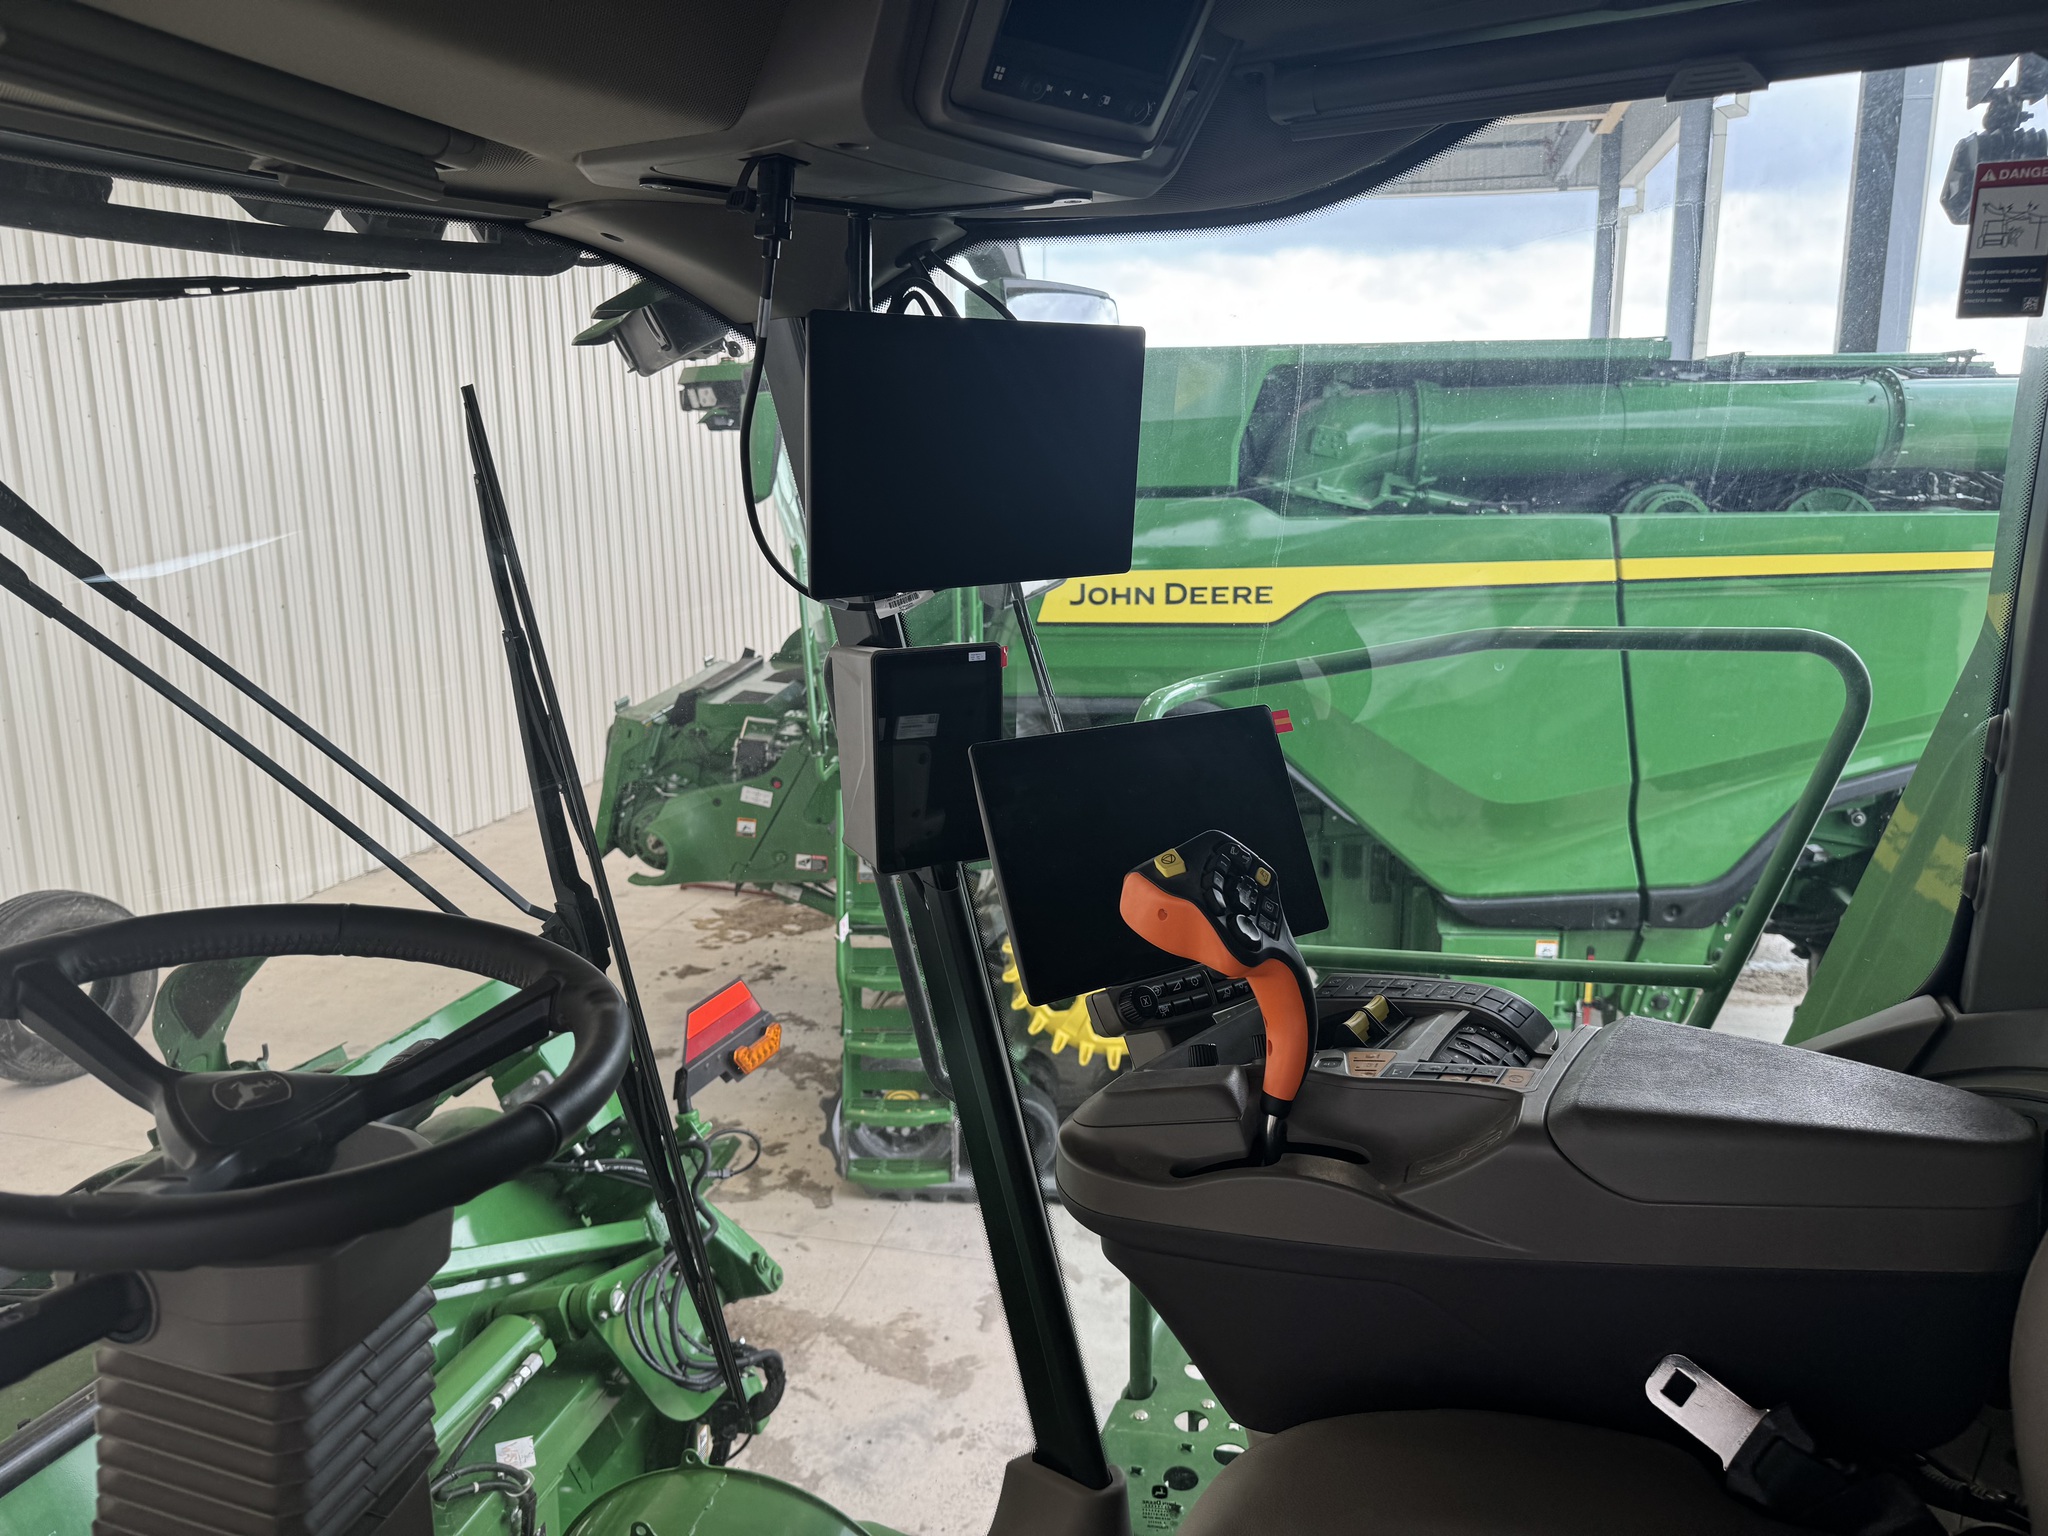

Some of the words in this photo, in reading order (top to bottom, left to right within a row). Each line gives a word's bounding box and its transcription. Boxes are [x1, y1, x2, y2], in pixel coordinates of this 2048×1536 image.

[1998, 167, 2048, 180] DANGE
[1069, 583, 1155, 606] JOHN
[1165, 582, 1273, 605] DEERE
